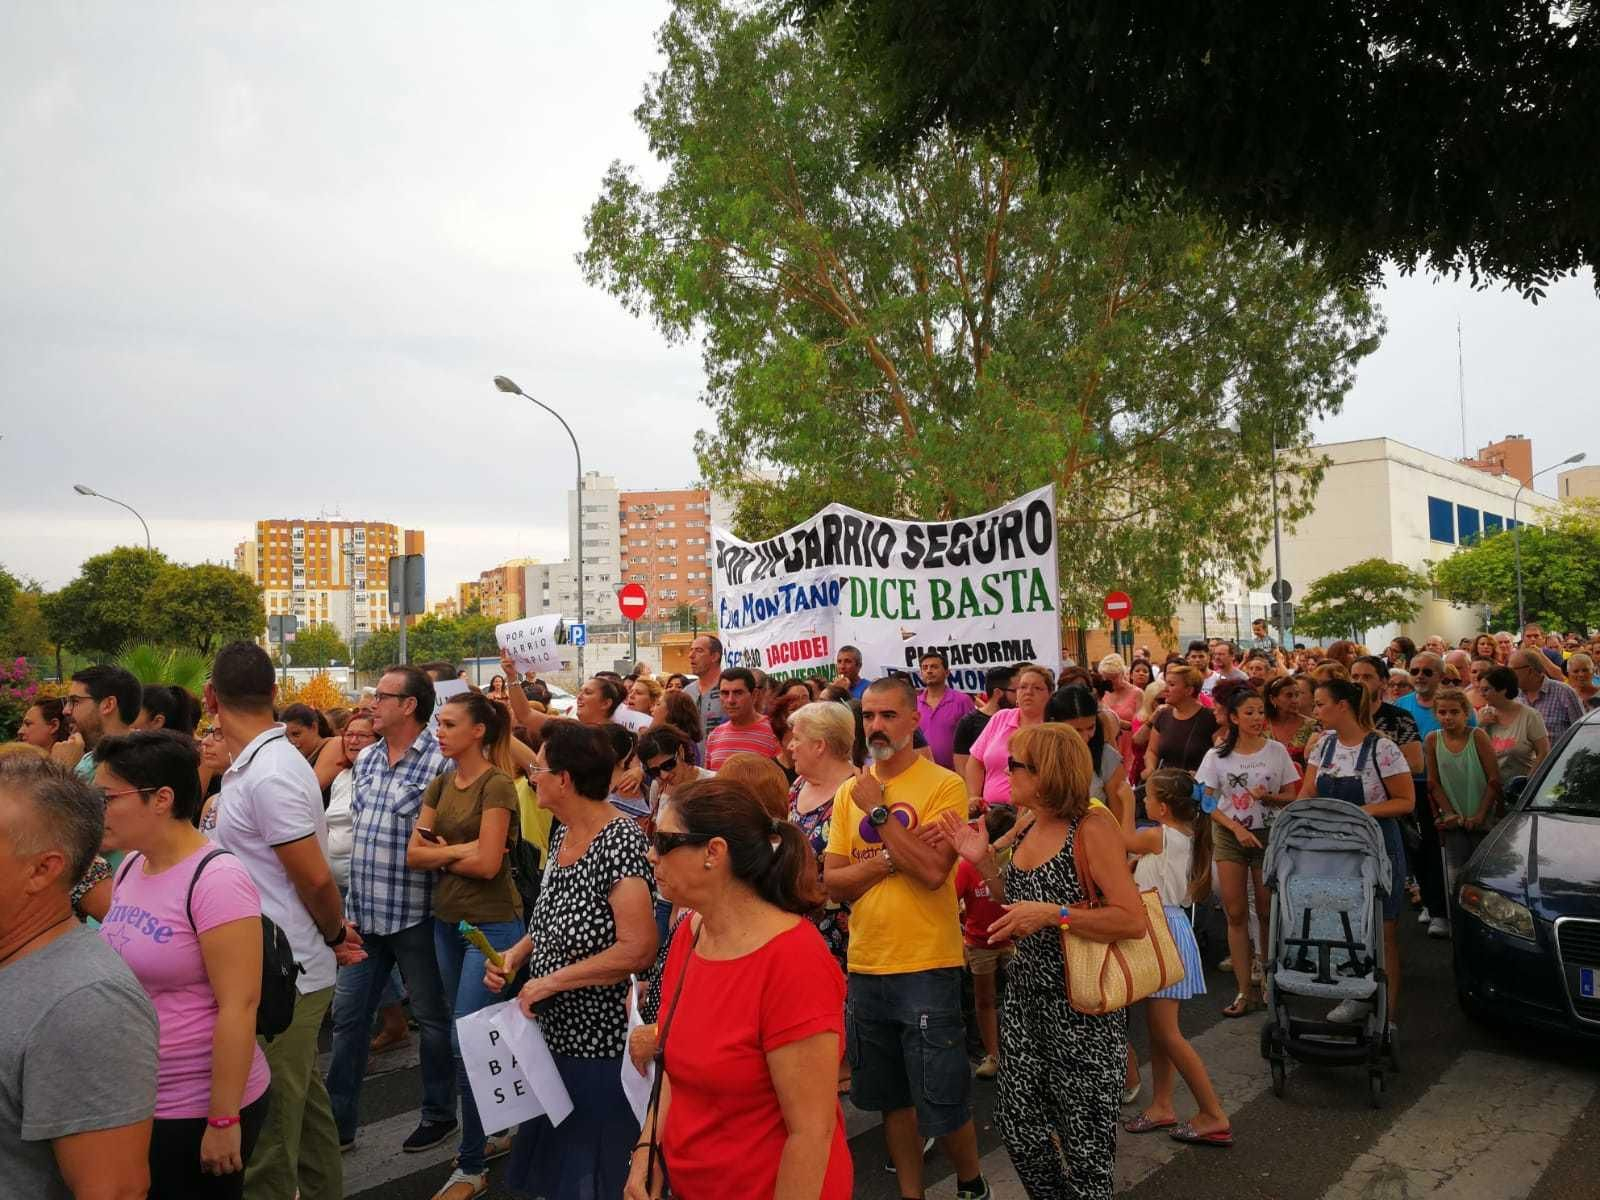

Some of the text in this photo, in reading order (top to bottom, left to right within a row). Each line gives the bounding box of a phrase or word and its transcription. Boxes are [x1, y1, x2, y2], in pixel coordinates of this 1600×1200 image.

[901, 499, 1053, 570] SEGURO
[742, 579, 840, 627] MONTANO
[848, 576, 921, 620] DICE
[928, 567, 1055, 621] BASTA
[505, 625, 543, 642] POR UN
[572, 626, 583, 645] P
[765, 635, 829, 669] ¡ACUDE!
